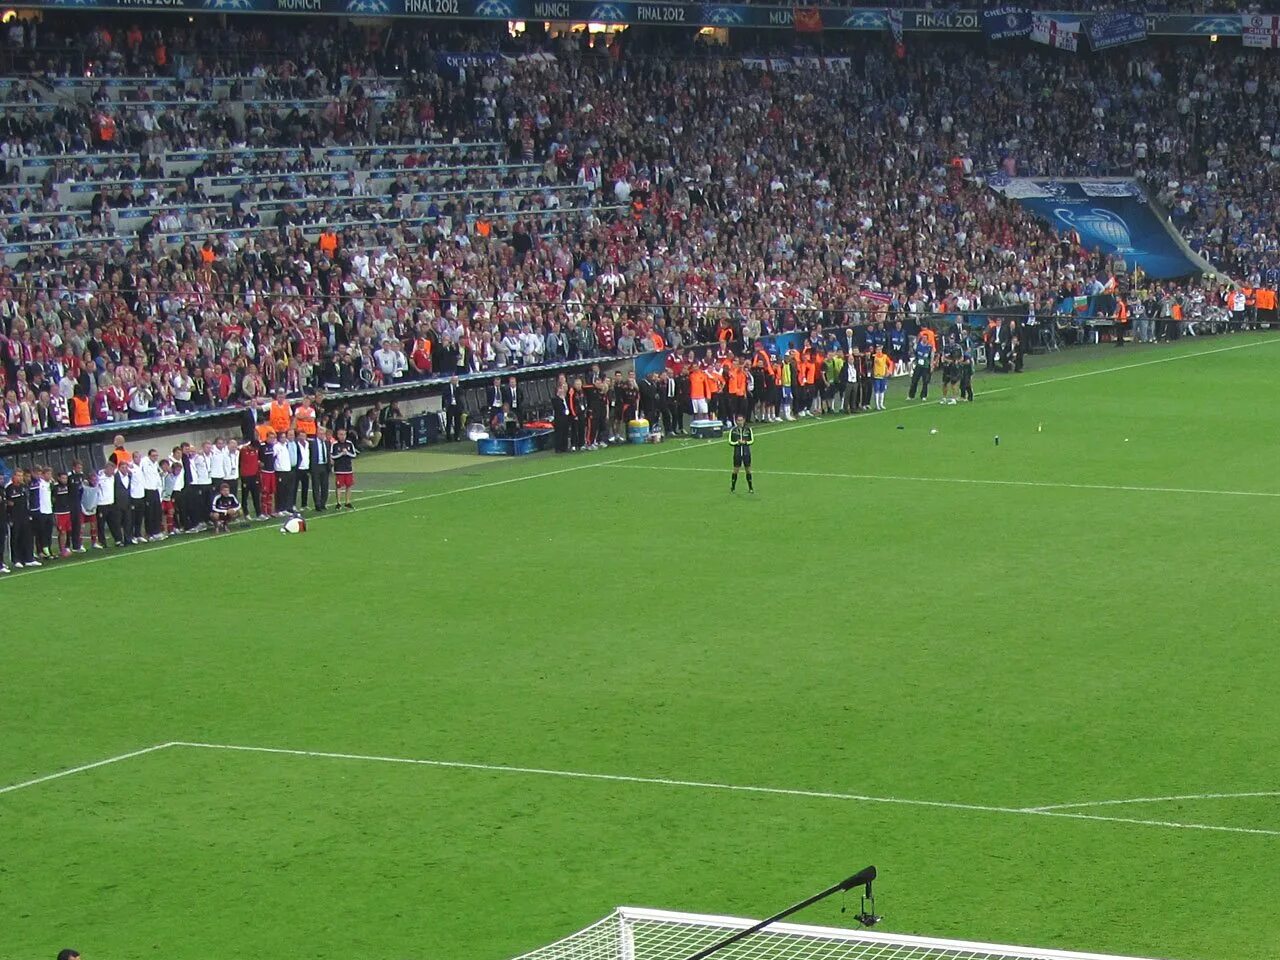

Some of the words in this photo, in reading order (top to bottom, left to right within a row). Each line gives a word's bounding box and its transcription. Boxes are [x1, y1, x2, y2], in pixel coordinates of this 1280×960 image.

[278, 0, 321, 9] MUNICH
[405, 0, 434, 12] FINAL
[436, 1, 459, 13] 2012
[534, 4, 570, 17] MUNICH
[637, 7, 662, 20] FINAL
[663, 8, 685, 21] 2012
[769, 11, 795, 25] MUN
[983, 7, 1021, 17] CHELSEA
[916, 14, 954, 26] FINAL
[955, 15, 978, 27] 201
